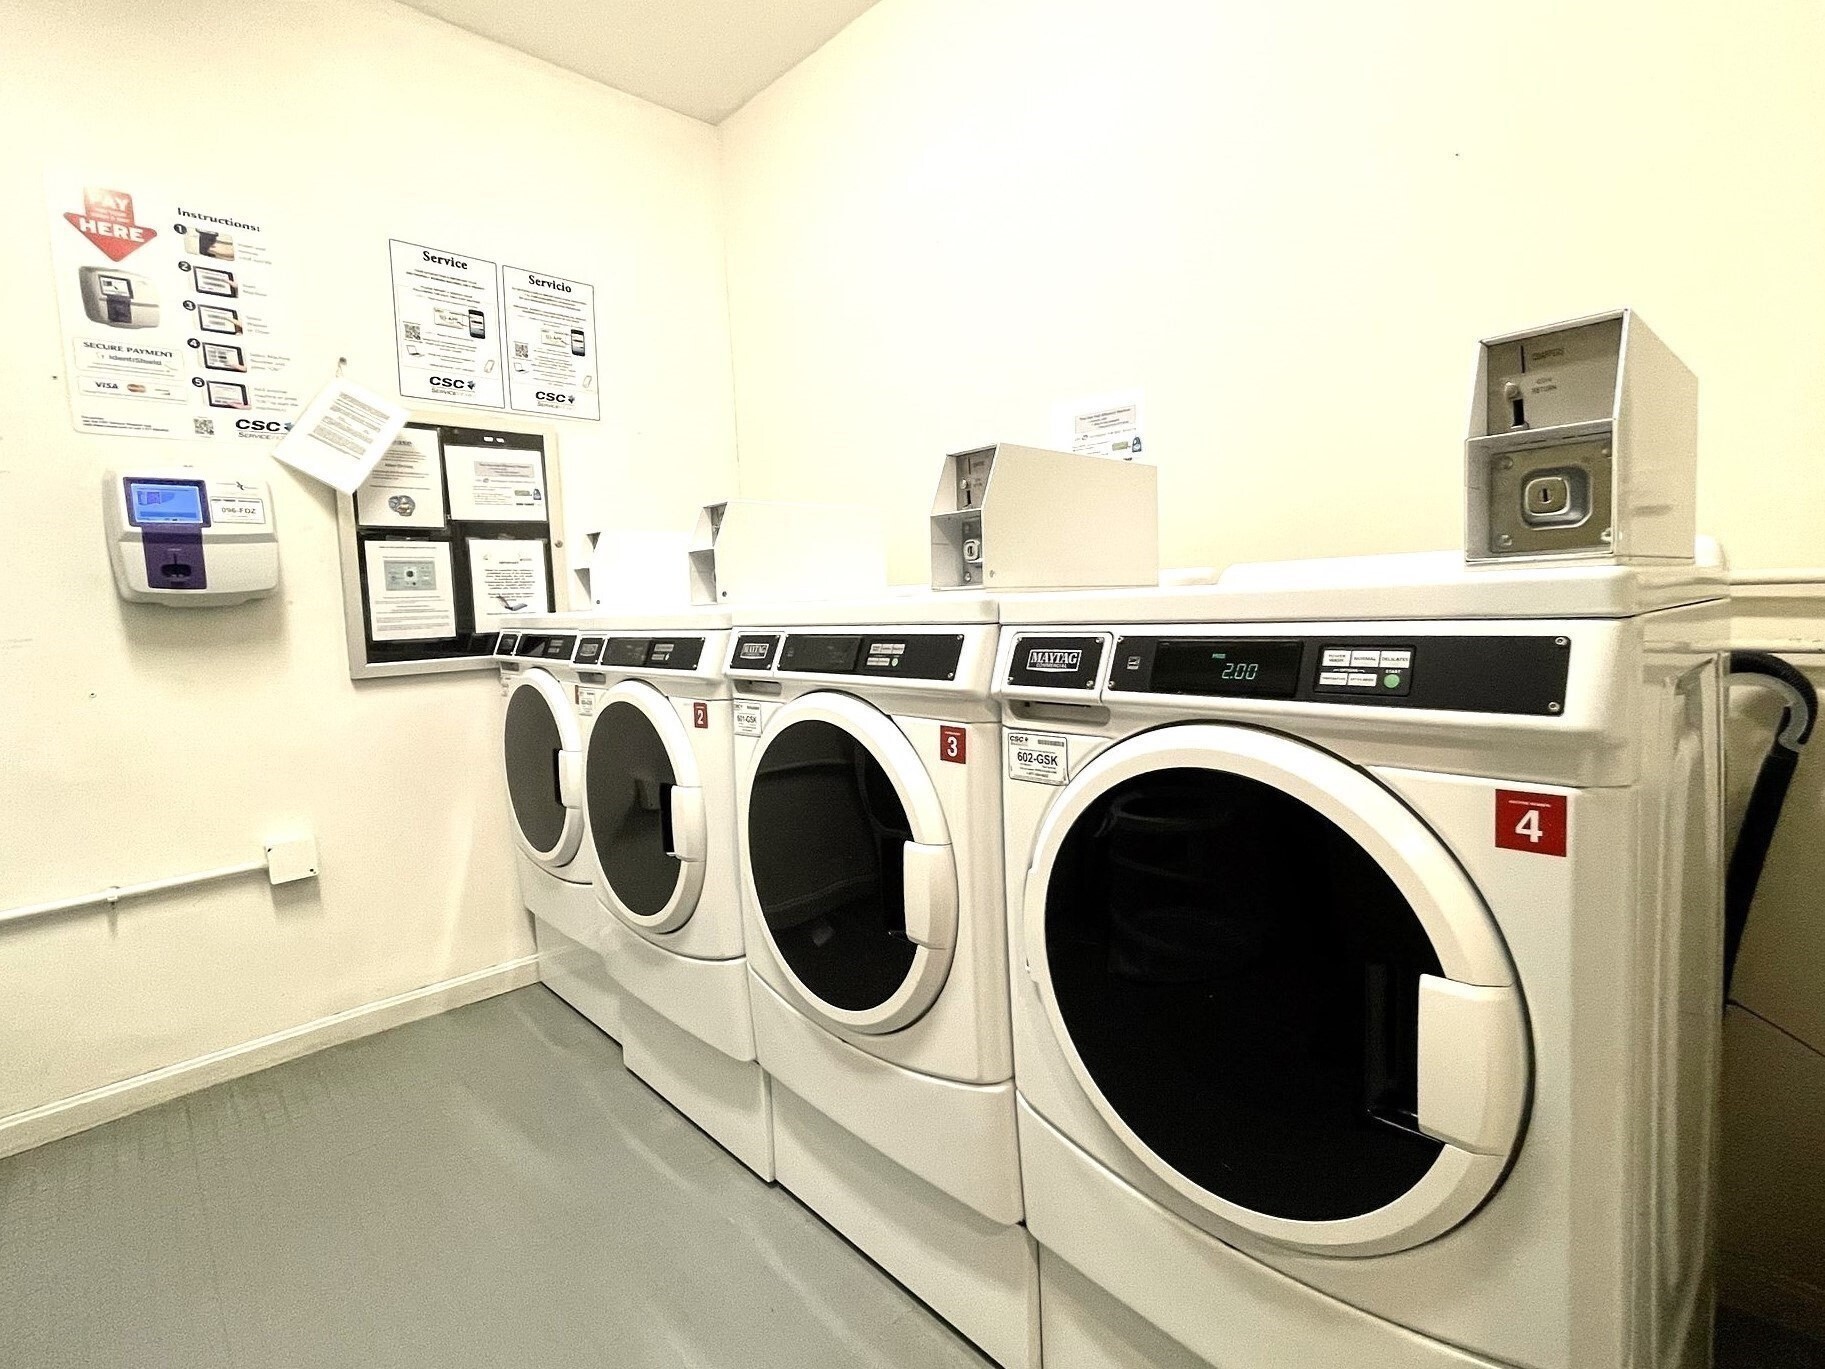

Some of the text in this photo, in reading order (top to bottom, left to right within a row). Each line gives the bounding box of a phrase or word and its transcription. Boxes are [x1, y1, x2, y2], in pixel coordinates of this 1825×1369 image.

[79, 217, 145, 243] HERE
[422, 250, 468, 270] Service
[528, 274, 572, 293] Servicio
[83, 341, 173, 358] SECURE PAYMENT
[95, 381, 119, 390] VISA
[429, 376, 465, 389] CSC
[535, 391, 566, 403] CSC
[235, 418, 281, 432] CSC
[1030, 652, 1078, 664] MAYTAG
[1221, 663, 1259, 680] 2.00
[697, 709, 704, 725] 2
[946, 736, 958, 757] 3
[1017, 751, 1058, 767] 602-GSK
[1515, 809, 1543, 843] 4
